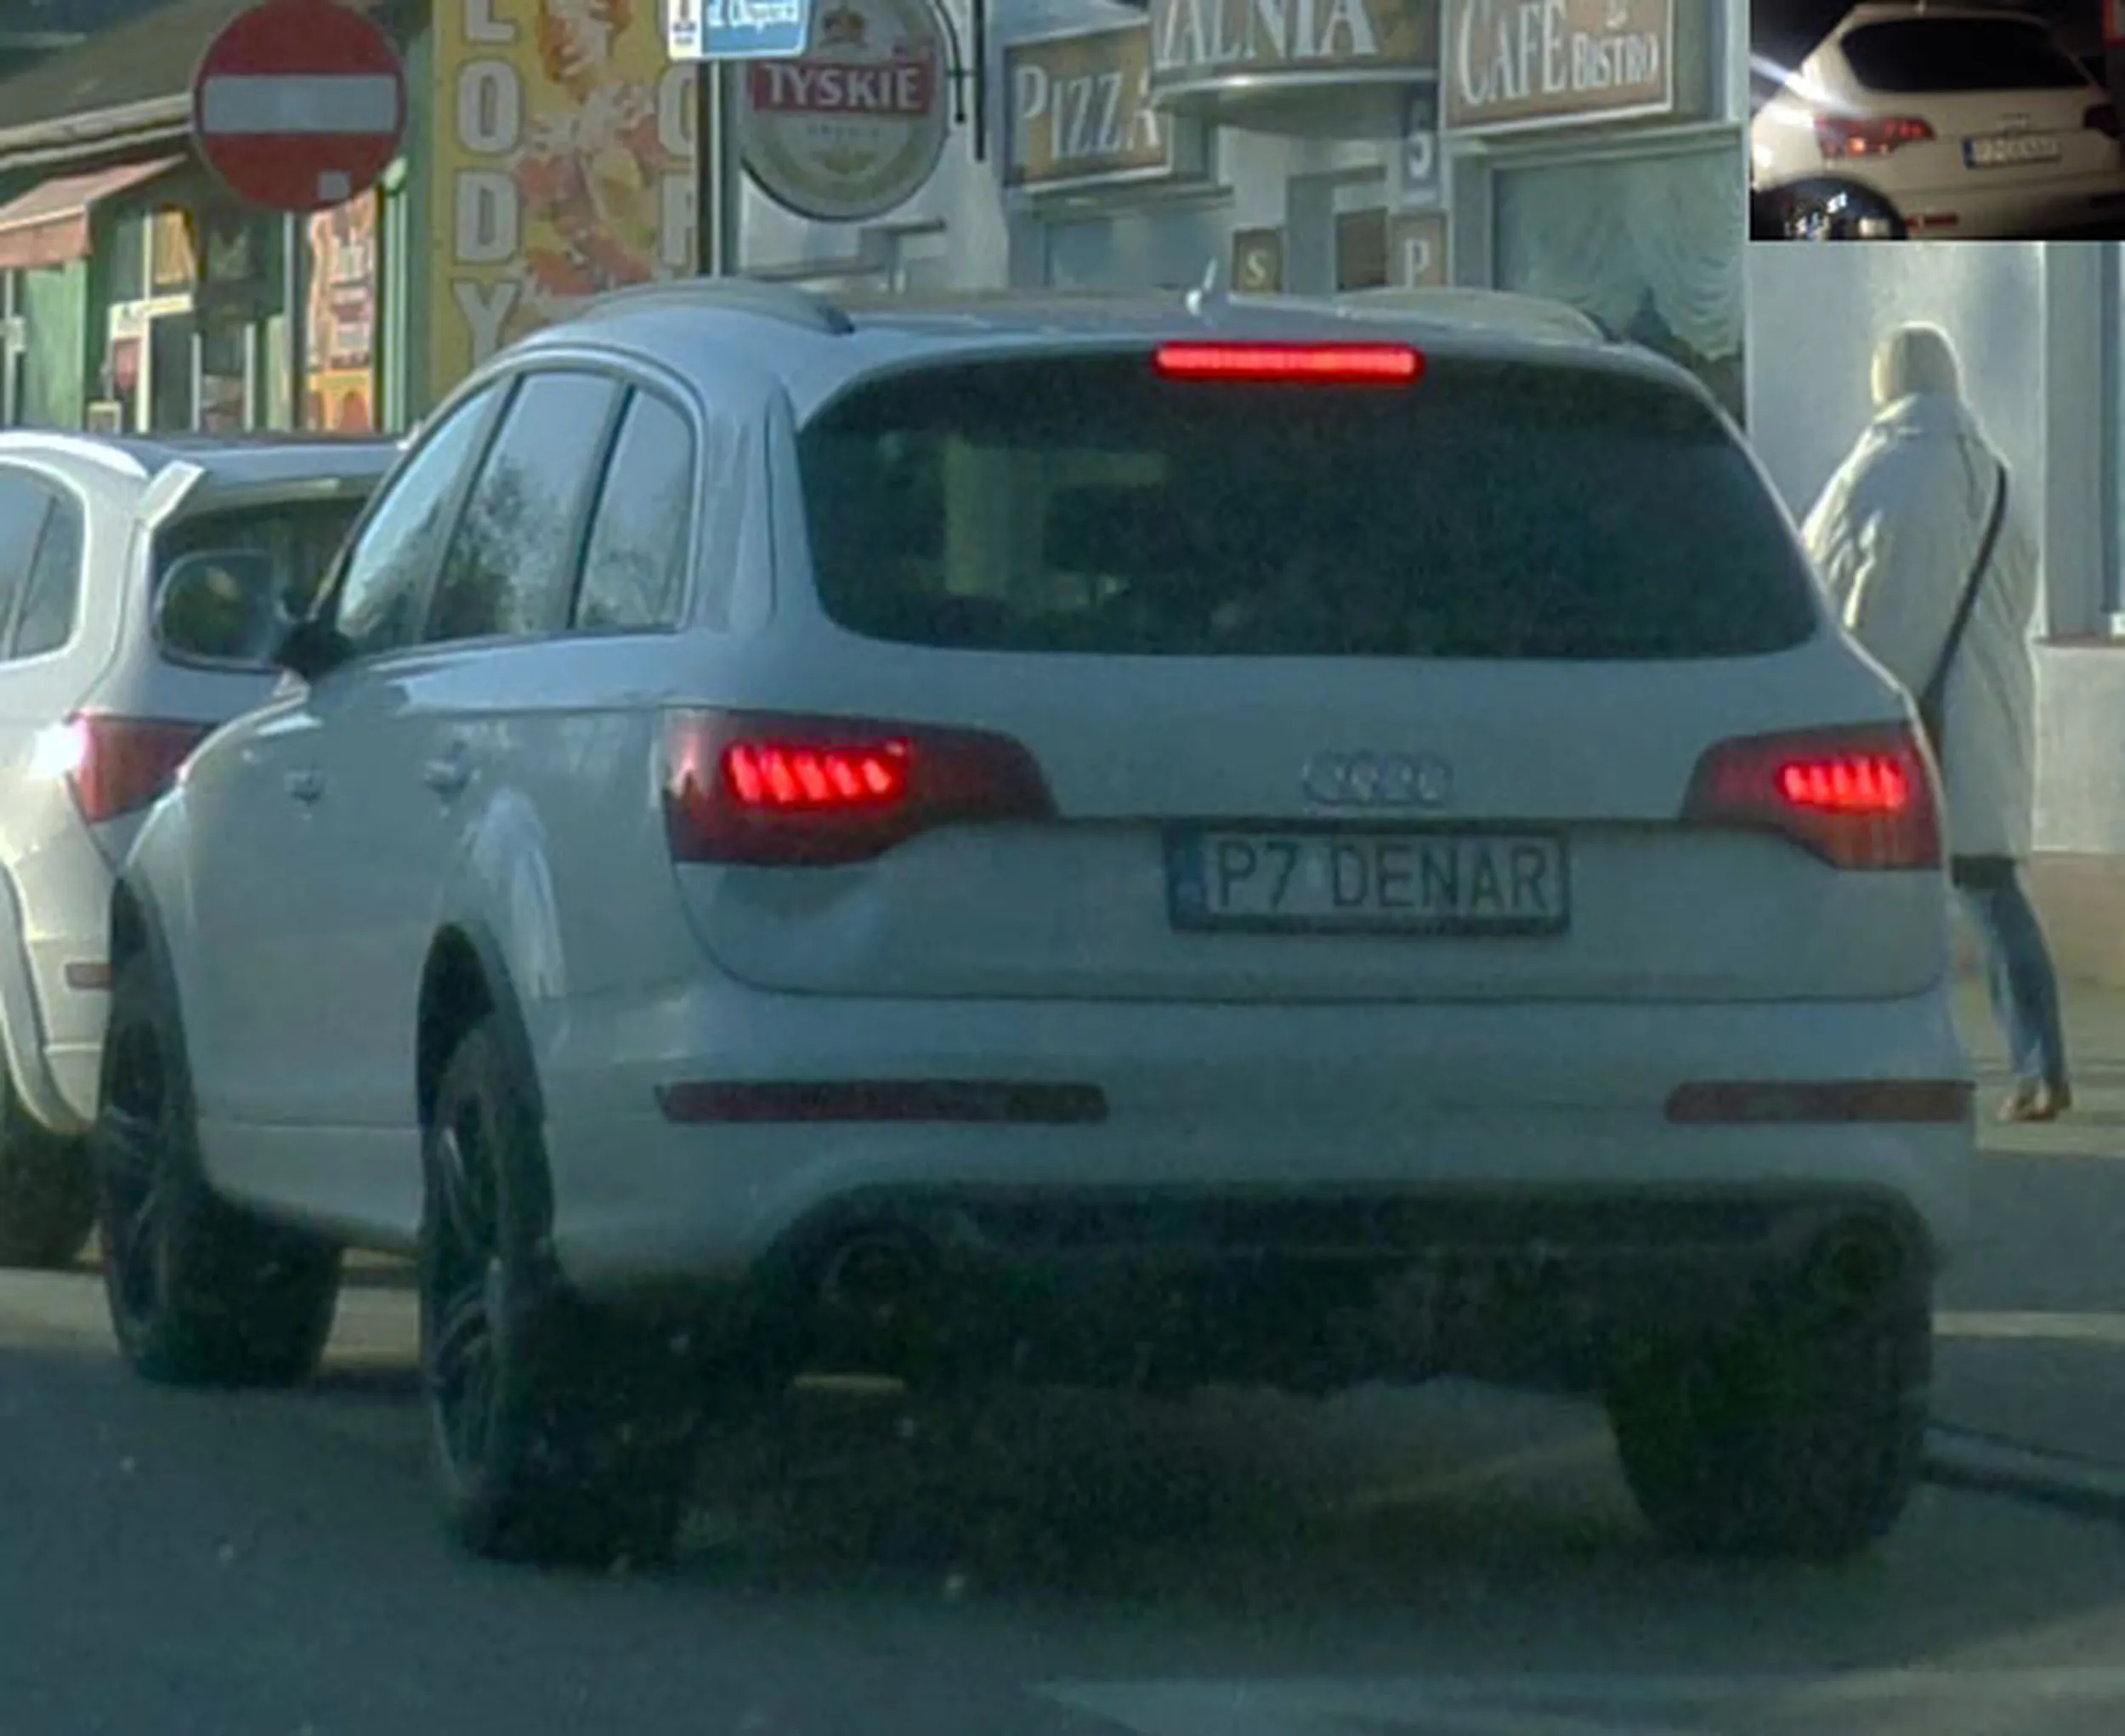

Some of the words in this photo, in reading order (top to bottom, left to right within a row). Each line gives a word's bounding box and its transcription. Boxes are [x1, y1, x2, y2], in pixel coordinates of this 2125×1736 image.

[760, 60, 923, 111] TYSKIE
[1572, 31, 1659, 90] BISTRO
[1015, 63, 1162, 167] PIZZA
[1404, 238, 1430, 288] P
[1216, 841, 1299, 907] P7
[1331, 843, 1549, 909] DENAR
